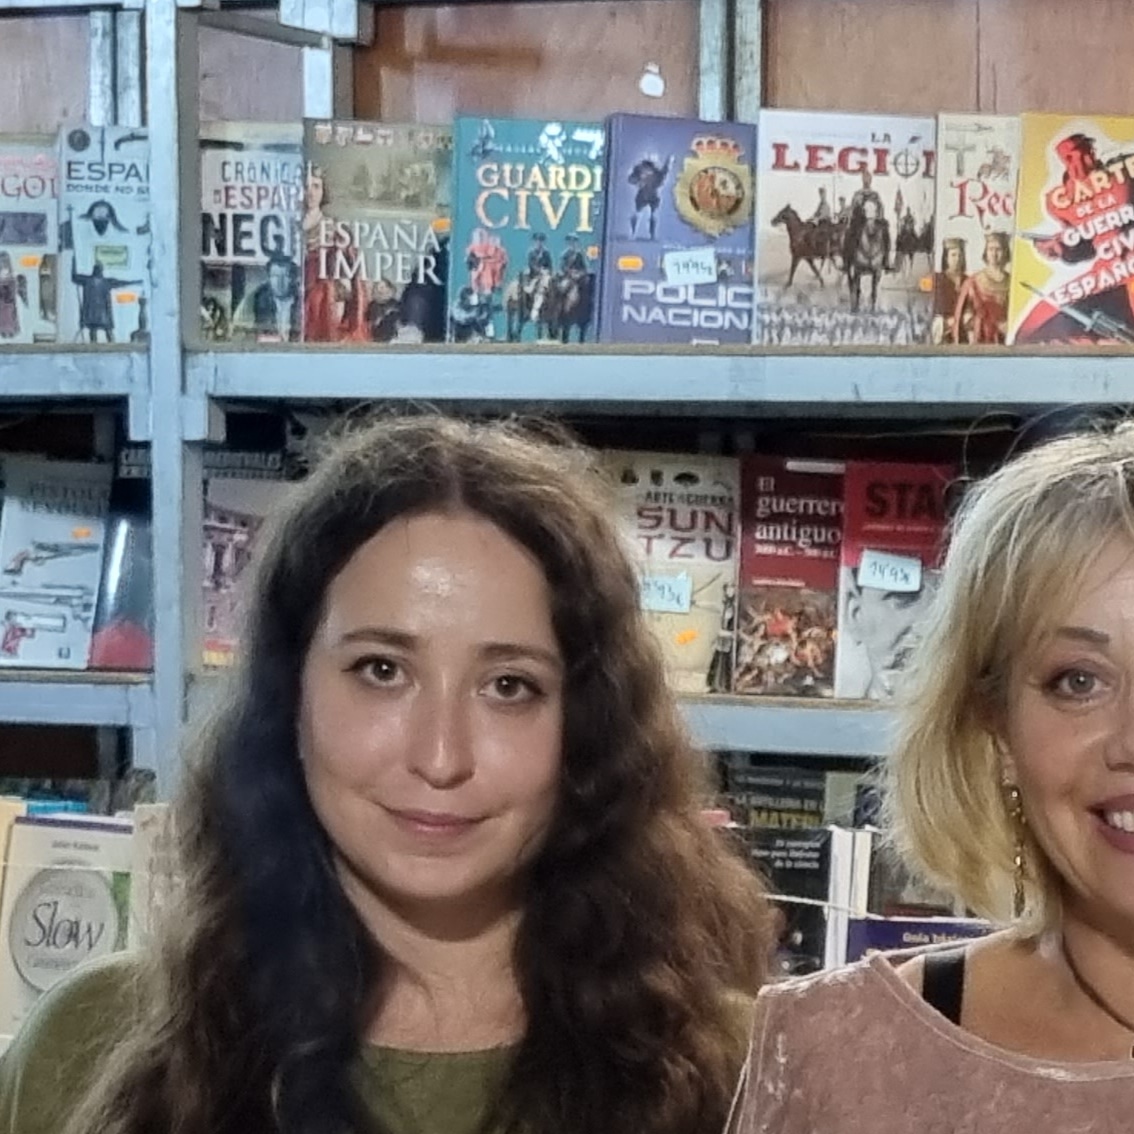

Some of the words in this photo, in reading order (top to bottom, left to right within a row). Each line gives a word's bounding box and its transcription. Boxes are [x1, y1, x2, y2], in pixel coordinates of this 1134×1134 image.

[870, 132, 892, 144] LA
[66, 161, 149, 182] ESPA
[1076, 204, 1094, 218] DE
[1098, 193, 1116, 209] LA
[320, 218, 440, 252] ESPAÑA
[637, 505, 736, 537] SUN
[755, 519, 841, 548] antiguo
[637, 533, 733, 562] TZU
[25, 900, 105, 952] Slow
